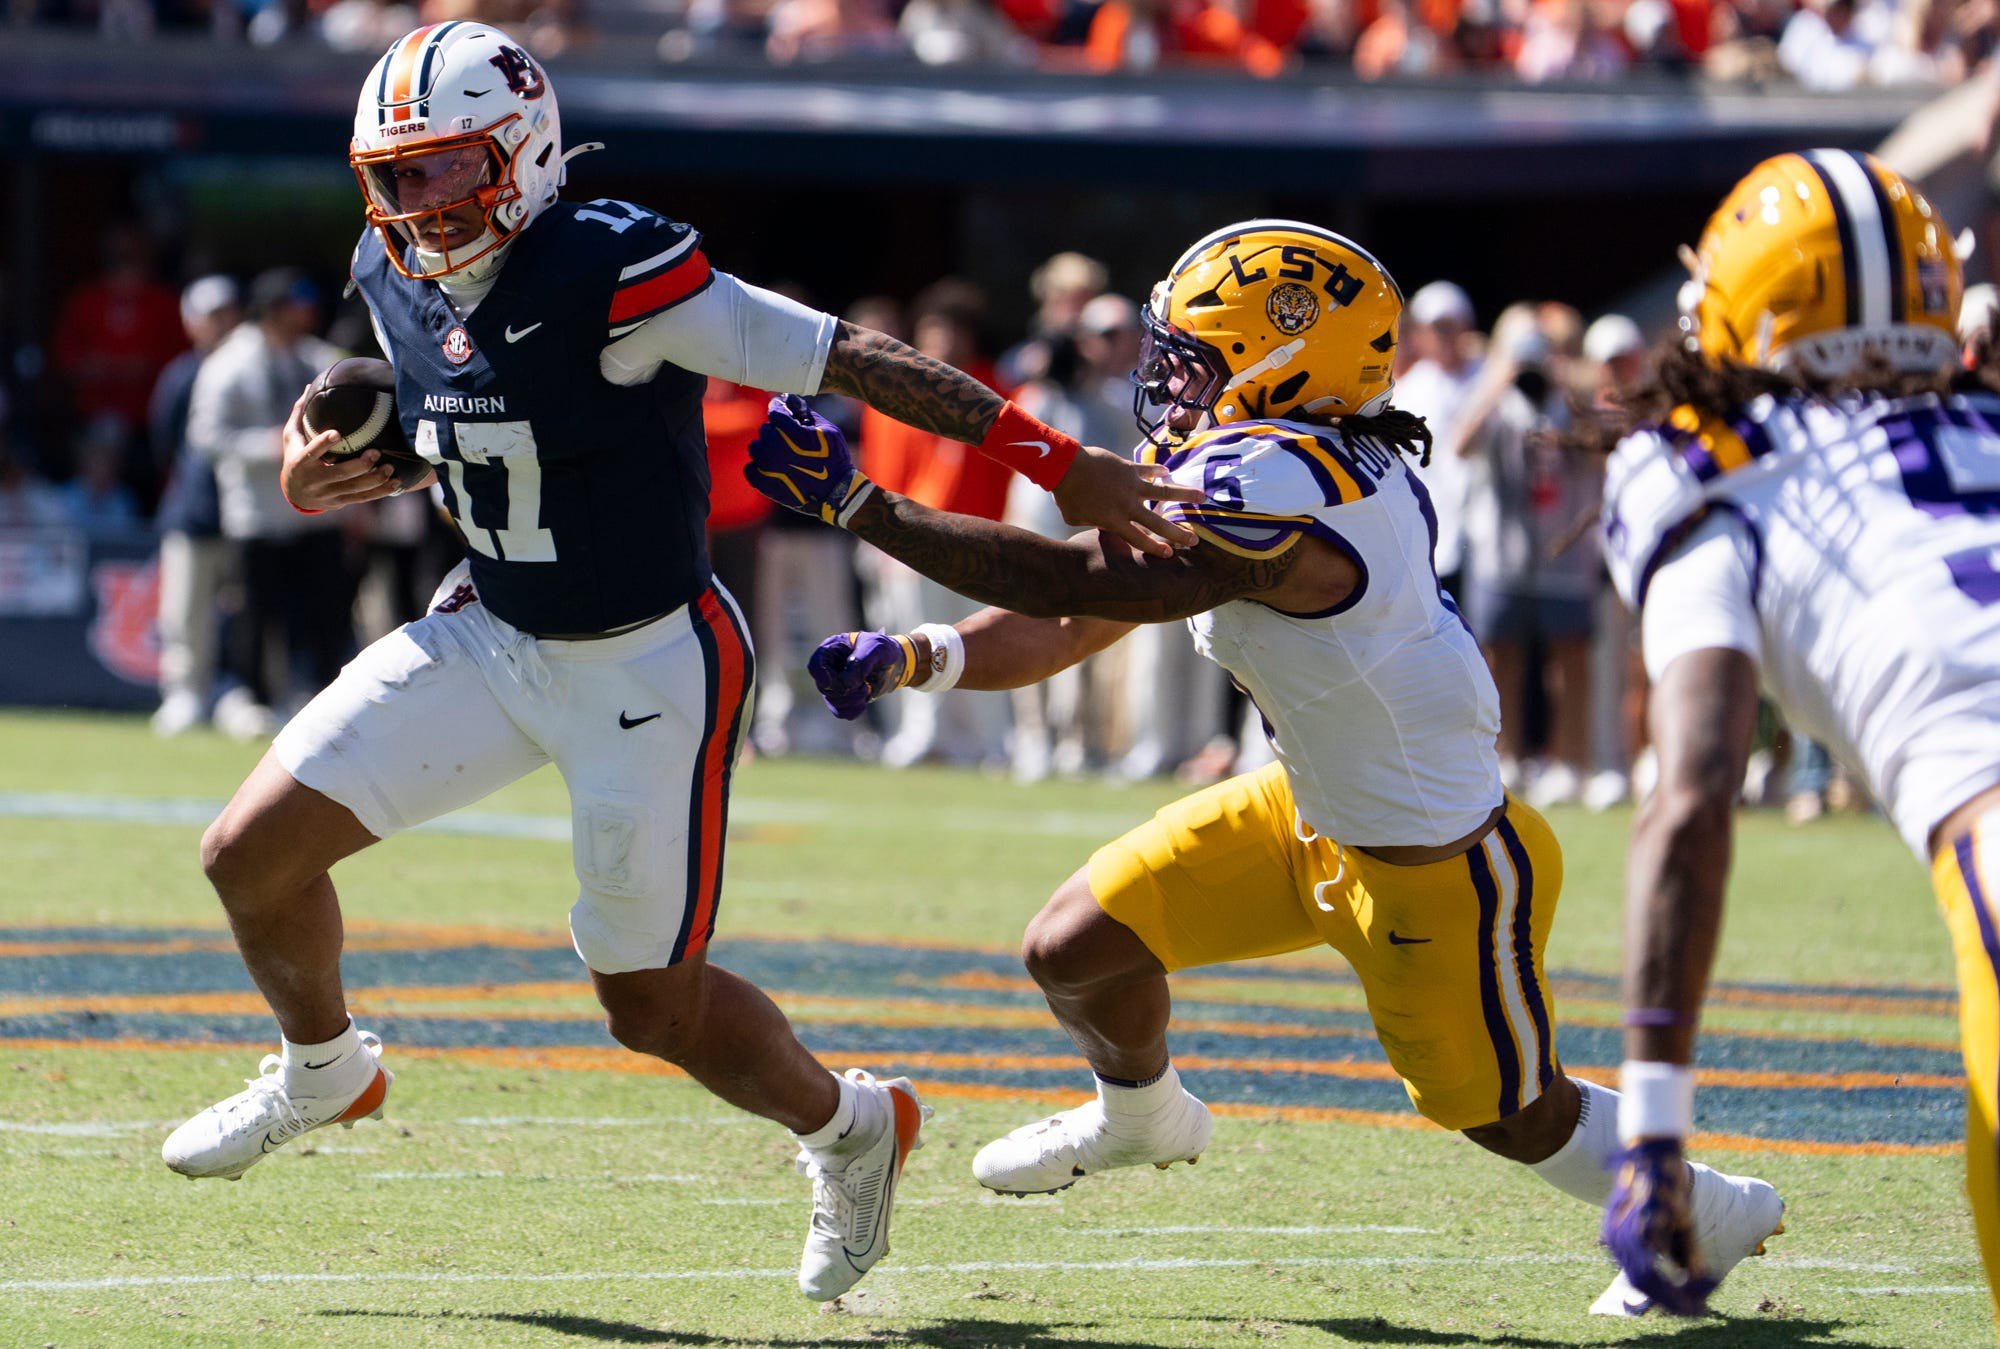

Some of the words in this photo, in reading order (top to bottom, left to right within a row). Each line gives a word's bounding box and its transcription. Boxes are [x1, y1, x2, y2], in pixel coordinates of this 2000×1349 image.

[379, 122, 426, 138] TIGERS
[461, 118, 473, 129] 17
[574, 198, 654, 234] 17
[423, 394, 506, 414] AUBURN
[415, 419, 558, 563] 17
[1204, 454, 1245, 512] 6
